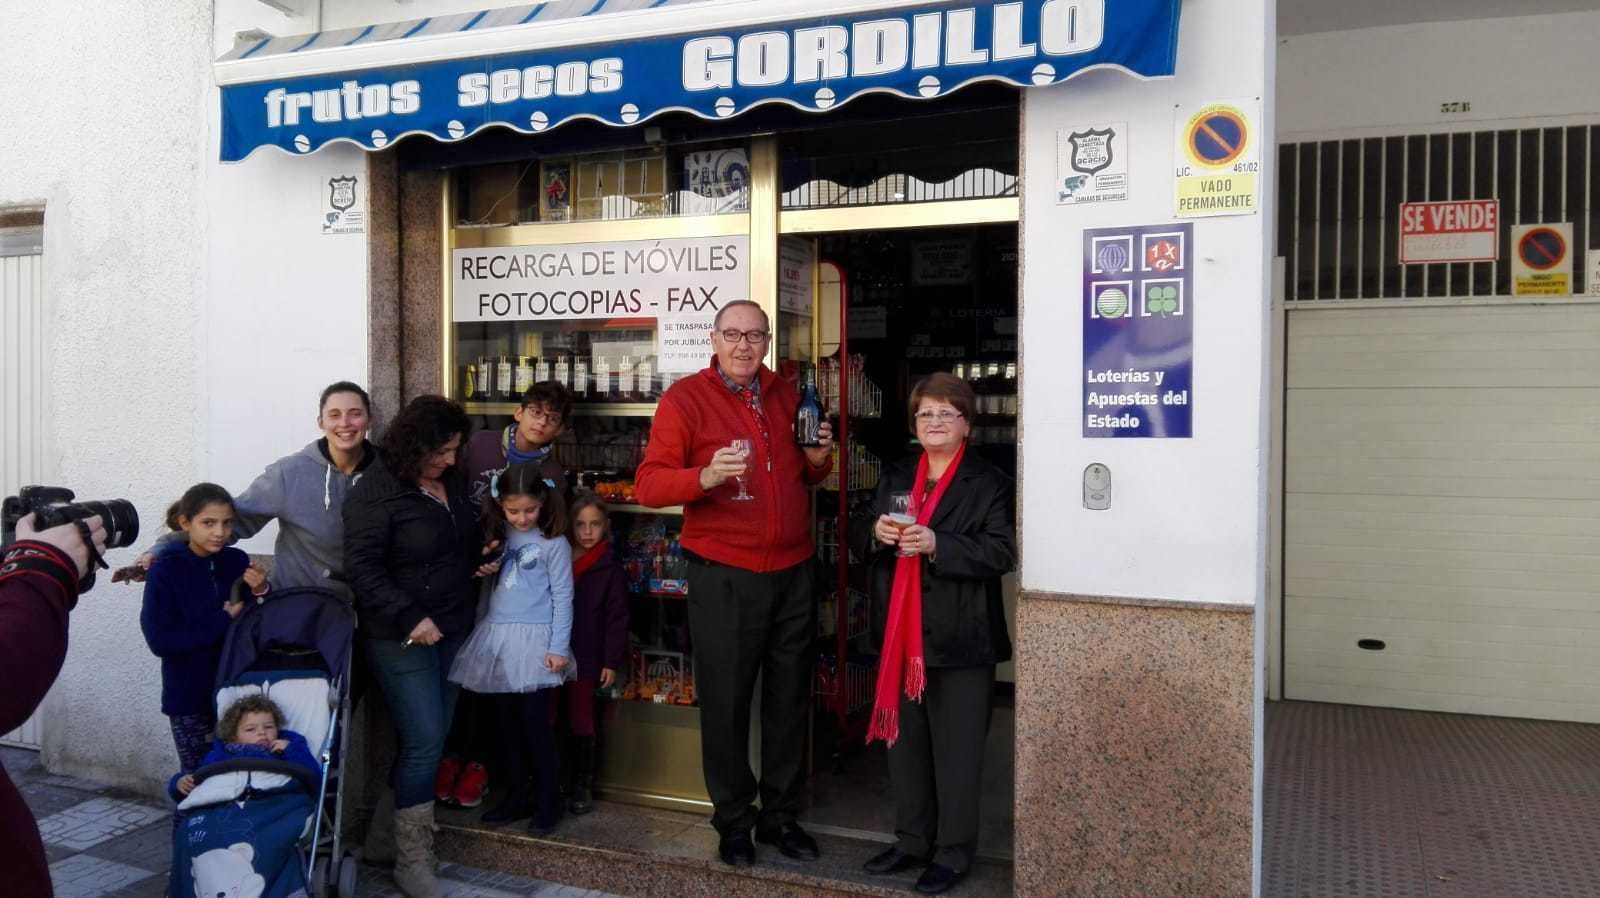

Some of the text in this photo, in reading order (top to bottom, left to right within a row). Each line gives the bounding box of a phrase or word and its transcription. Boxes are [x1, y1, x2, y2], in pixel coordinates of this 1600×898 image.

[264, 0, 1105, 128] frutos secos GORDILLO
[1176, 162, 1258, 177] LIC. 461/02
[1201, 179, 1232, 193] VADO
[1180, 194, 1252, 210] PERMANENTE
[1403, 203, 1496, 232] SE VENDE
[461, 241, 739, 280] RECARGA DE MÓVILES
[479, 288, 642, 316] FOTOCOPIAS
[667, 286, 719, 312] FAX
[664, 323, 713, 331] SE TRASPASA
[1087, 367, 1165, 386] Loterías y
[1087, 389, 1188, 408] Apuestas del
[1087, 413, 1140, 428] Estado
